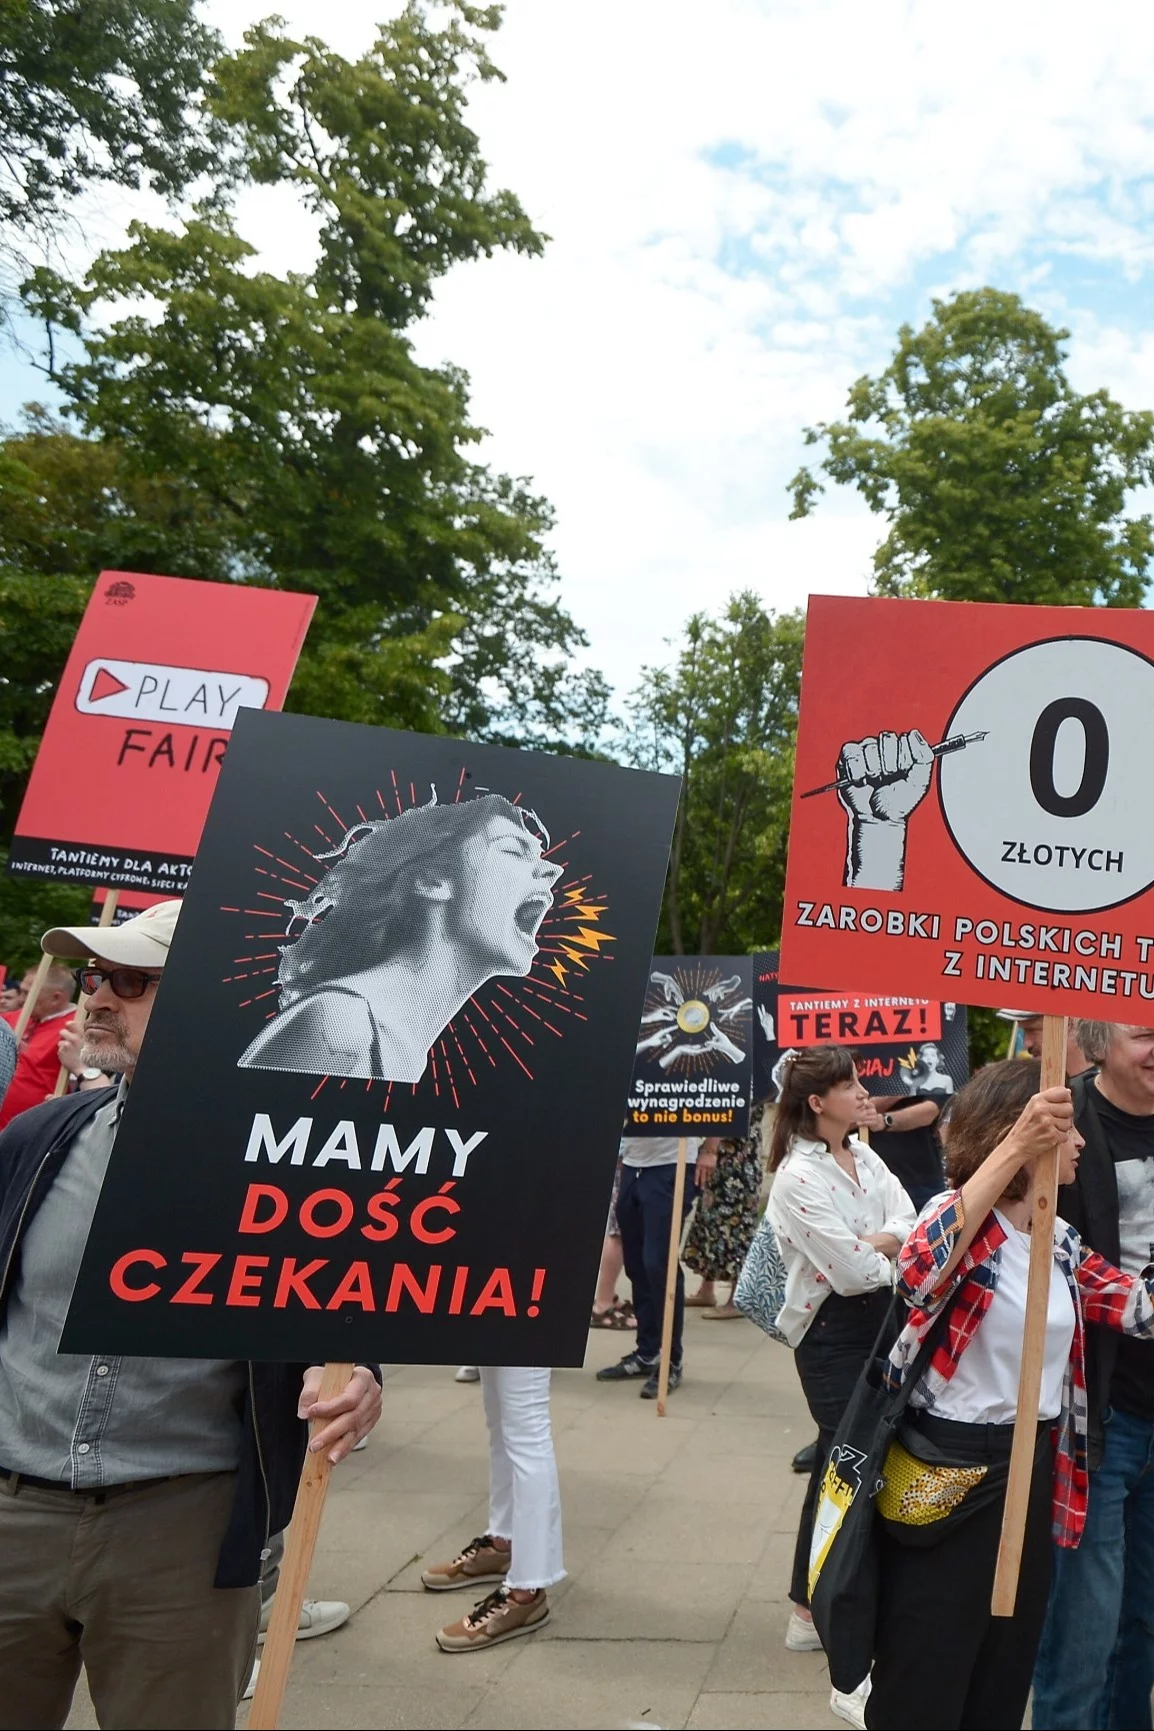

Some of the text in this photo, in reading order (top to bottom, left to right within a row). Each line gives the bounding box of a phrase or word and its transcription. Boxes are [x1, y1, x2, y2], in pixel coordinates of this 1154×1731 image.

[134, 675, 242, 717] PLAY
[117, 729, 230, 773] FAIR
[1029, 697, 1110, 818] 0
[50, 847, 119, 868] TANTIEMY
[124, 857, 152, 873] DLA
[1001, 841, 1124, 873] ZŁOTYCH
[11, 861, 57, 875] INTERNET,
[57, 866, 110, 880] PLATFORMY
[151, 877, 175, 889] SIECI
[795, 901, 940, 940] ZAROBKI
[954, 917, 1122, 959] POLSKICH
[942, 950, 964, 977] Z
[789, 999, 849, 1011] TANTIEMY
[853, 999, 861, 1009] Z
[790, 1008, 928, 1040] TERAZ!
[627, 1093, 745, 1112] wynagrodzenie
[635, 1078, 740, 1097] Sprawiedliwe
[632, 1108, 733, 1123] to nie bonus!
[244, 1113, 489, 1177] MAMY
[238, 1178, 461, 1245] DOŚĆ
[109, 1249, 546, 1318] CZEKANIA!
